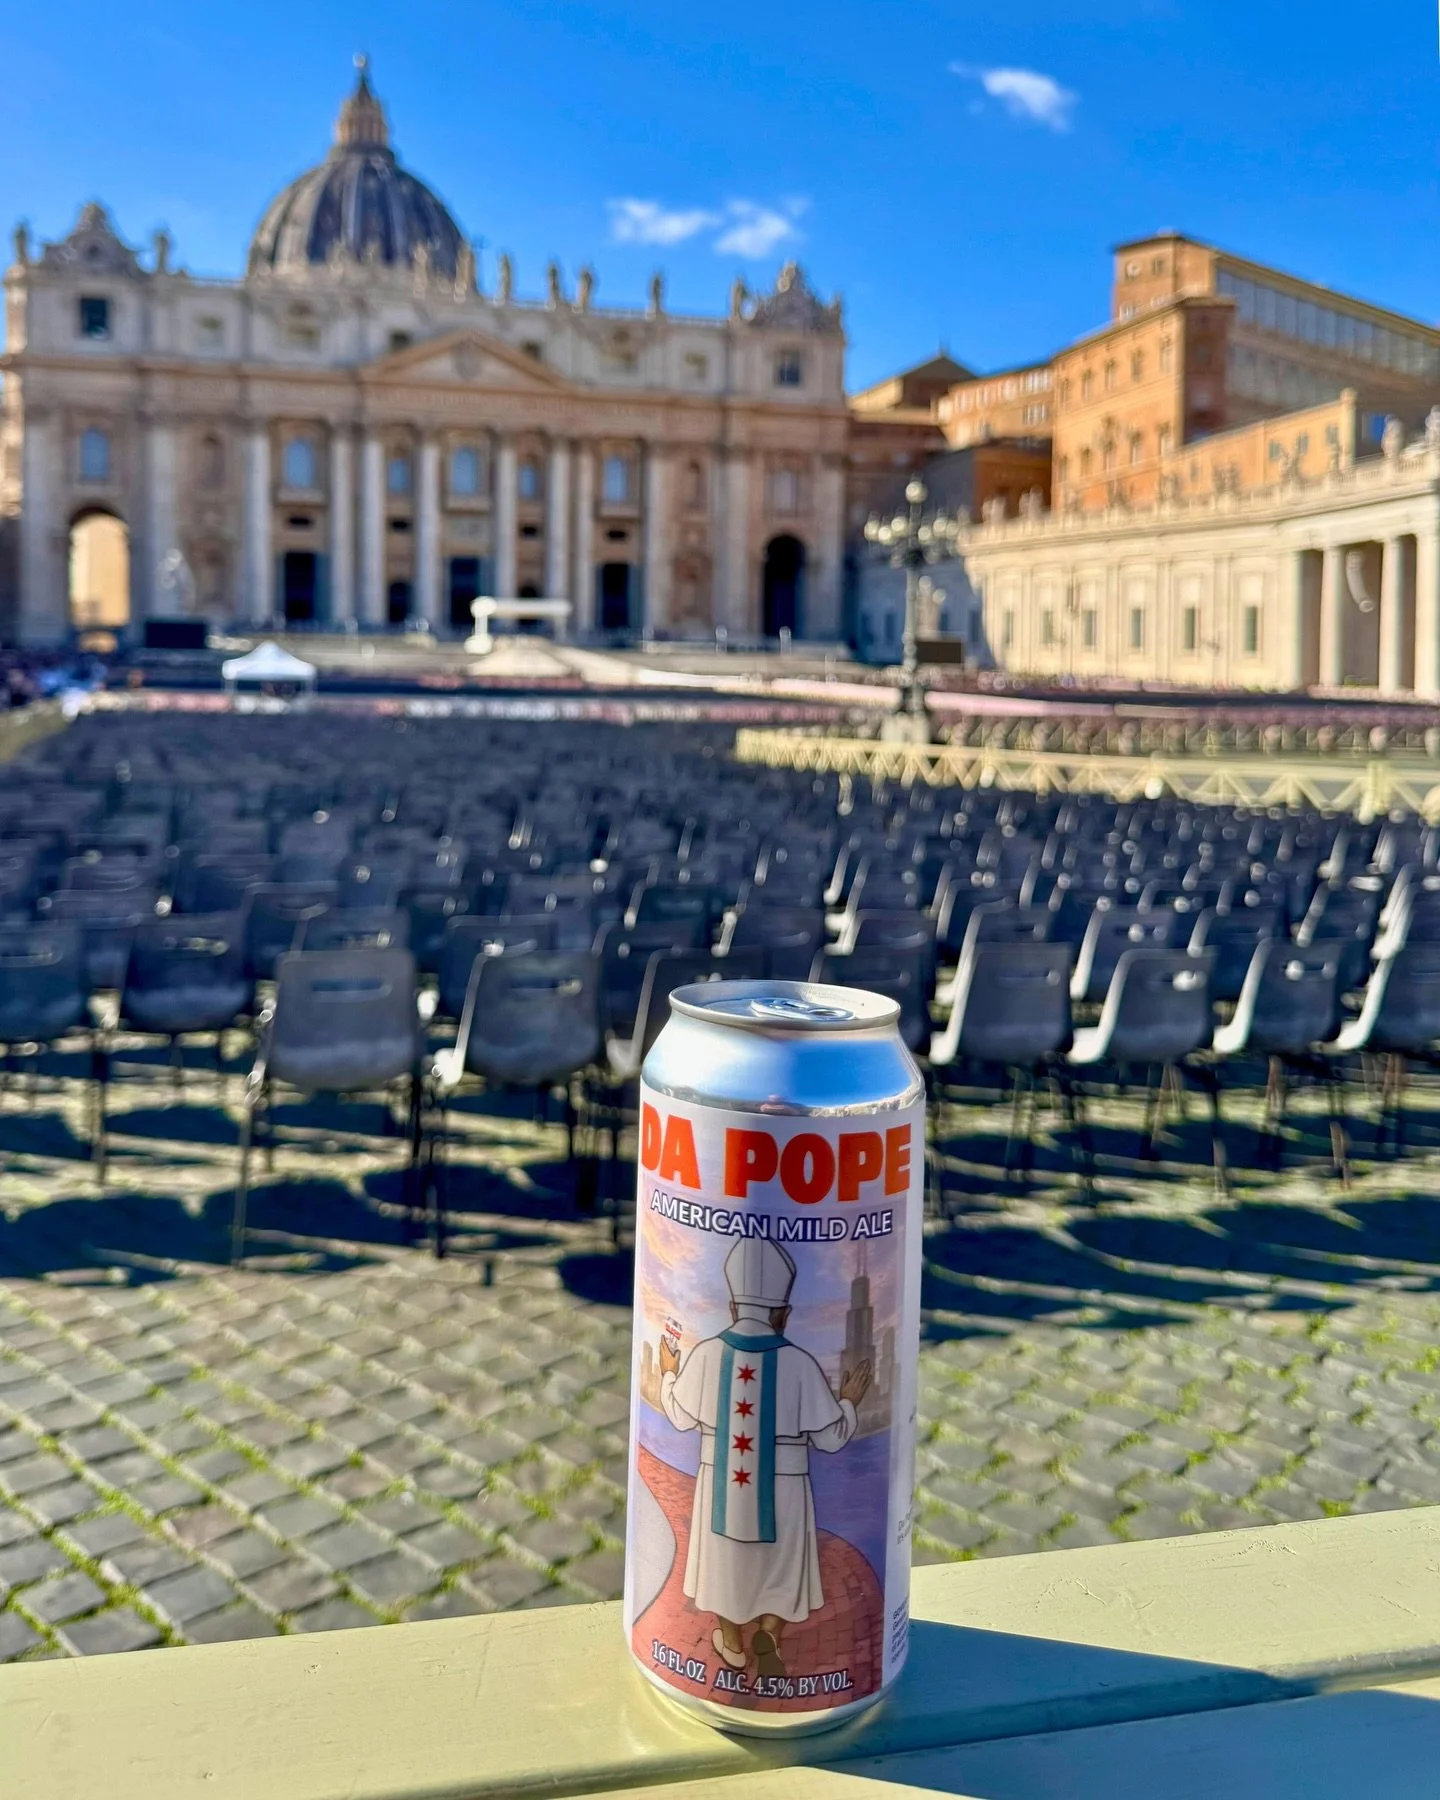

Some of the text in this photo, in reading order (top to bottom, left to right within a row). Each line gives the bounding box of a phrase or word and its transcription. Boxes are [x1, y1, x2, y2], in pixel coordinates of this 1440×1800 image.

[641, 1100, 912, 1205] DA POPE
[650, 1189, 893, 1241] AMERICAN MILD ALE
[652, 1640, 705, 1683] 16 FL OZ
[715, 1669, 853, 1697] ALC. 4.5% BY VOL.
